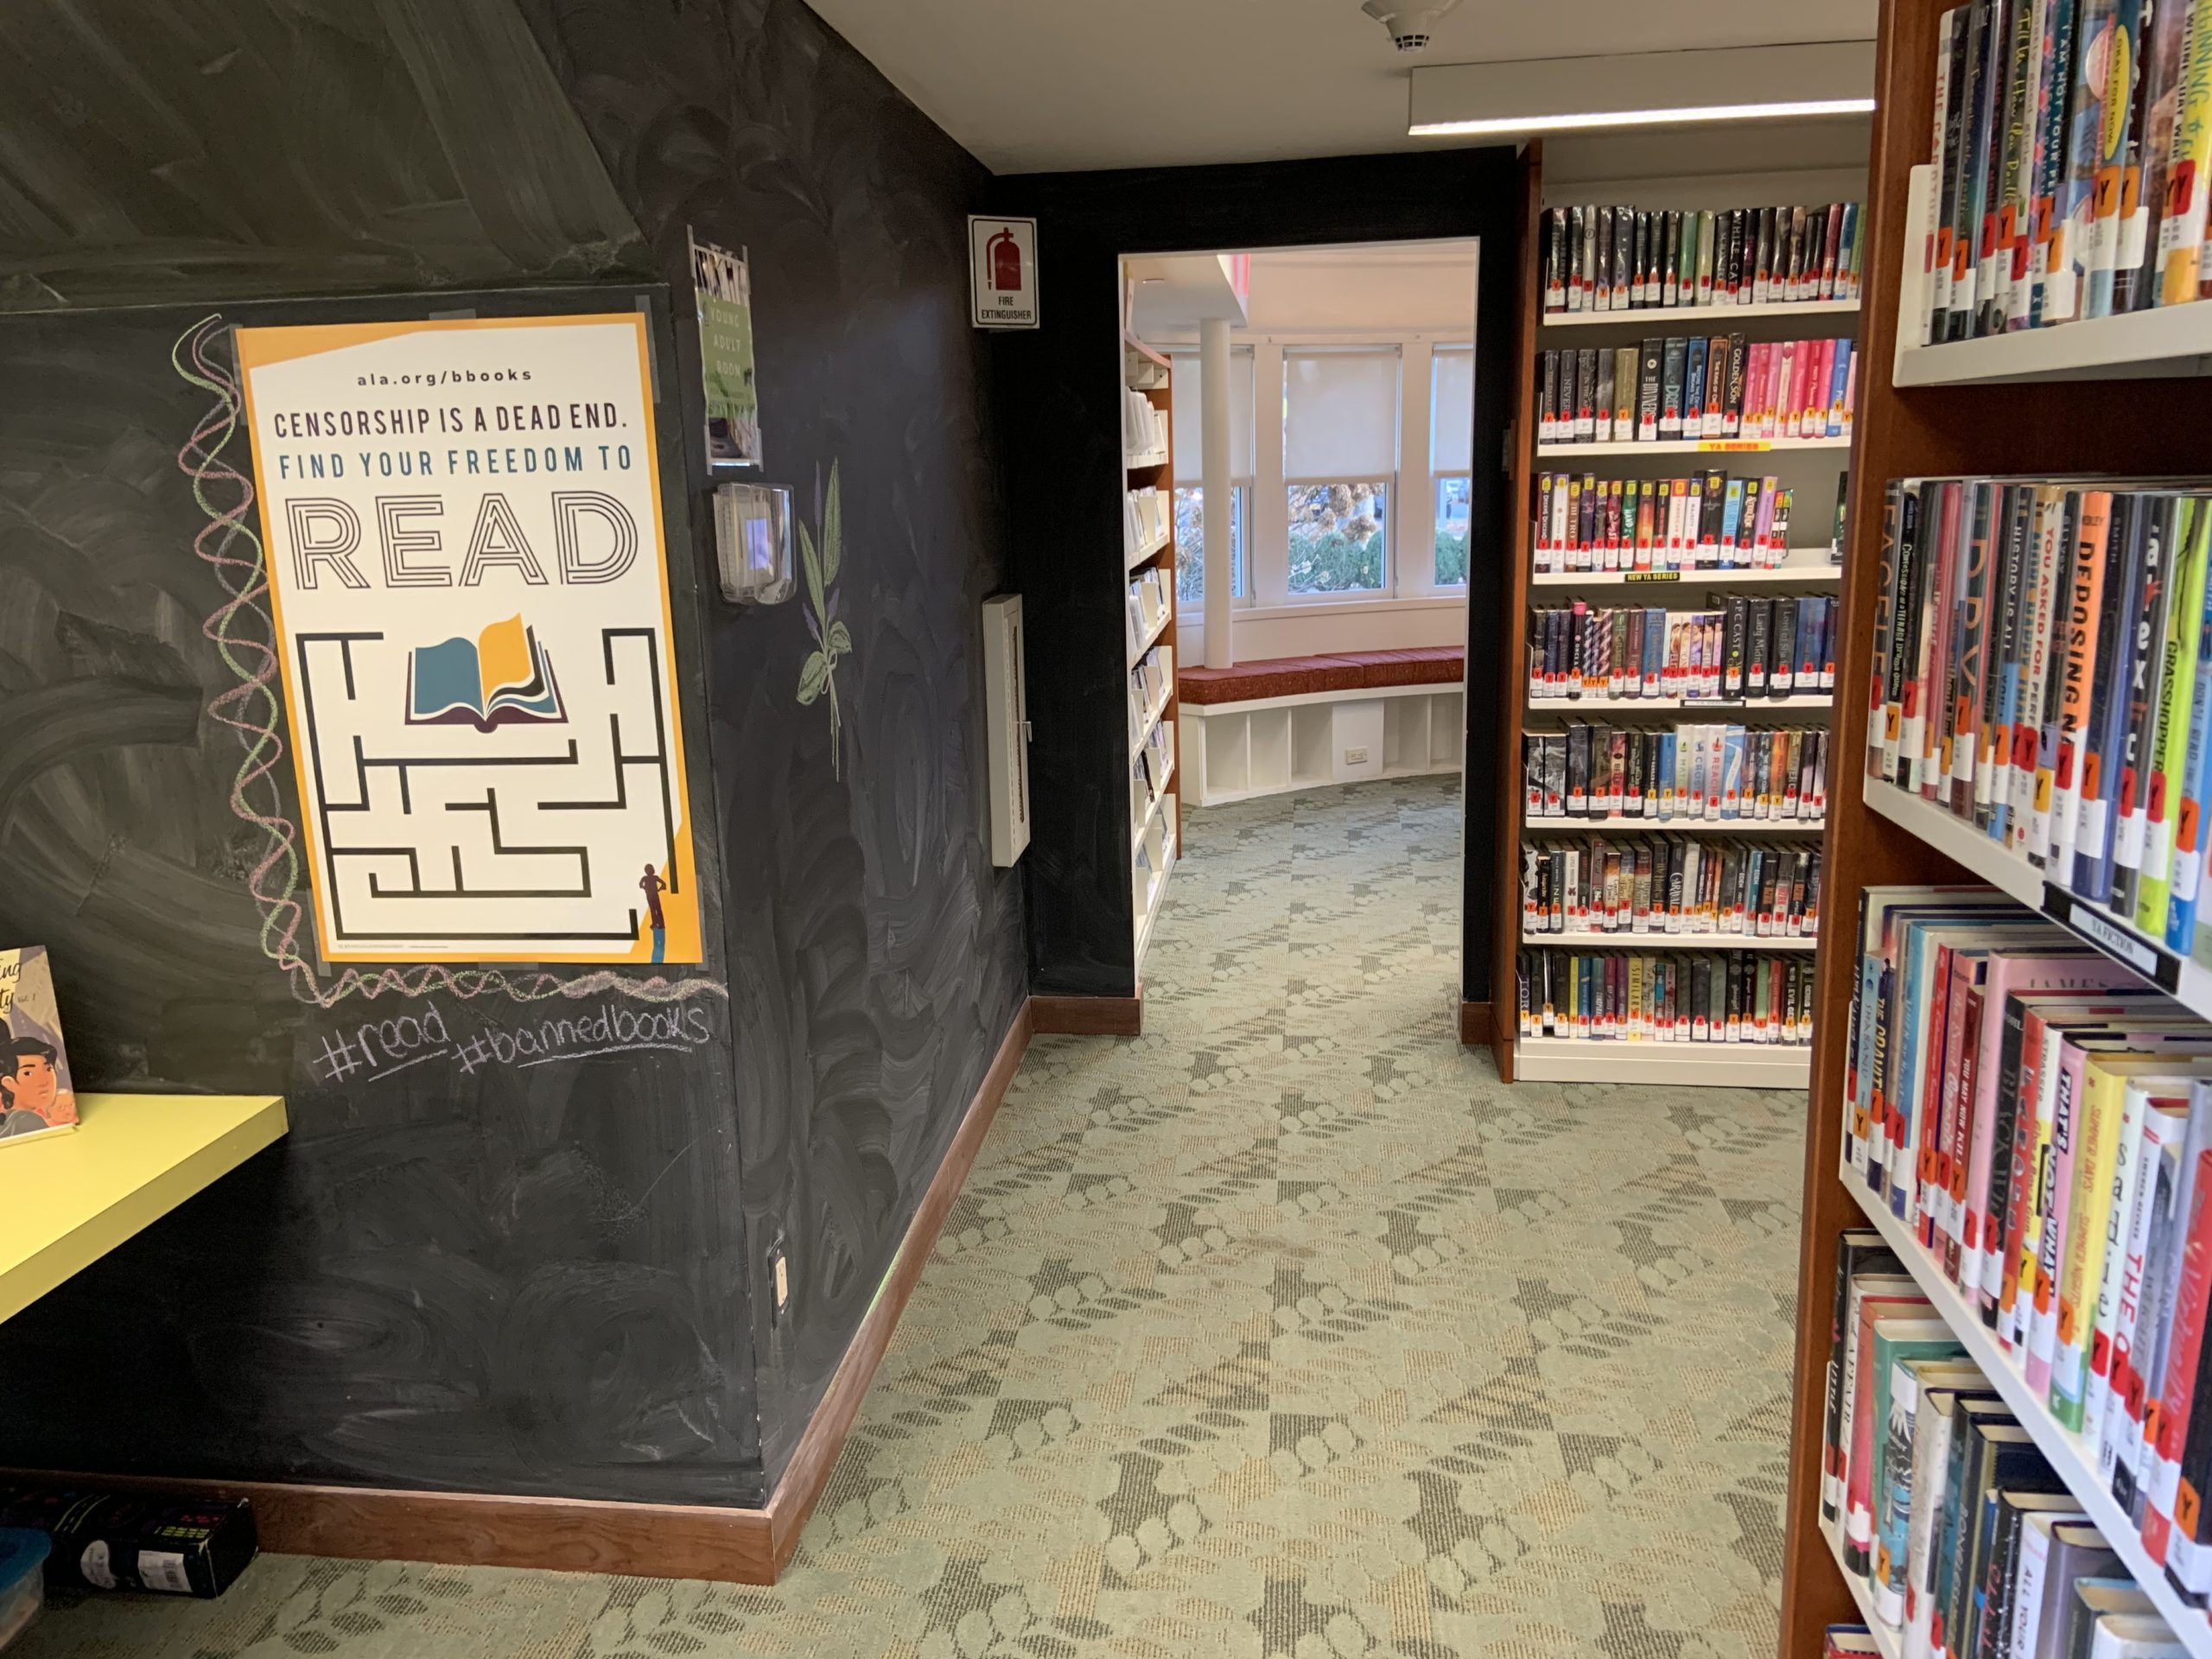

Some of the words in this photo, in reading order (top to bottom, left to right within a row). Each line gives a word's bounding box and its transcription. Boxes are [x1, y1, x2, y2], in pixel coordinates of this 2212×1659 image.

[2101, 180, 2110, 207] Y
[2122, 180, 2130, 207] Y
[2177, 175, 2188, 203] Y
[1938, 236, 1947, 256] Y
[1955, 249, 1962, 271] Y
[2013, 246, 2022, 271] Y
[982, 310, 1032, 320] EXTINGUISHER
[998, 296, 1014, 306] FIRE
[709, 307, 740, 327] YOUNG
[713, 334, 741, 353] ADULT
[357, 368, 532, 386] ala.org/bbooks
[1732, 348, 1742, 383] GOLDEN
[274, 409, 429, 438] CENSORSHIP
[440, 408, 463, 432] IS
[475, 407, 487, 432] A
[496, 404, 561, 431] DEAD
[569, 403, 626, 429] END.
[279, 454, 344, 480] FIND
[359, 451, 433, 477] YOUR
[448, 447, 583, 474] FREEDOM
[598, 445, 631, 471] TO
[285, 491, 639, 589] READ
[2044, 527, 2054, 569] YOU
[2037, 574, 2049, 634] ASKED
[1732, 625, 1743, 649] CAST
[1753, 613, 1766, 636] Lady
[2032, 641, 2044, 676] FOR
[2154, 641, 2178, 772] GRASSHOPPER
[1887, 714, 1895, 732] Y
[2024, 740, 2033, 762] Y
[2058, 756, 2067, 778] Y
[2036, 779, 2044, 800] Y
[2149, 785, 2159, 810] Y
[2102, 925, 2134, 955] FICTION
[313, 1001, 450, 1082] #read
[451, 1005, 710, 1074] #bannedbooks
[1861, 1003, 1872, 1079] SHABANU
[1962, 1058, 1972, 1080] YOU
[1961, 1082, 1969, 1103] MAY
[1959, 1106, 1968, 1129] NOW
[2056, 1067, 2072, 1154] THAT'S
[2087, 1105, 2102, 1158] SUMMER
[2044, 1143, 2057, 1212] NOT
[2082, 1159, 2097, 1193] DAYS
[2079, 1216, 2090, 1263] SUMMER
[2120, 1255, 2143, 1323] THE
[2021, 1565, 2034, 1602] ALL
[2015, 1608, 2030, 1650] YOUR
